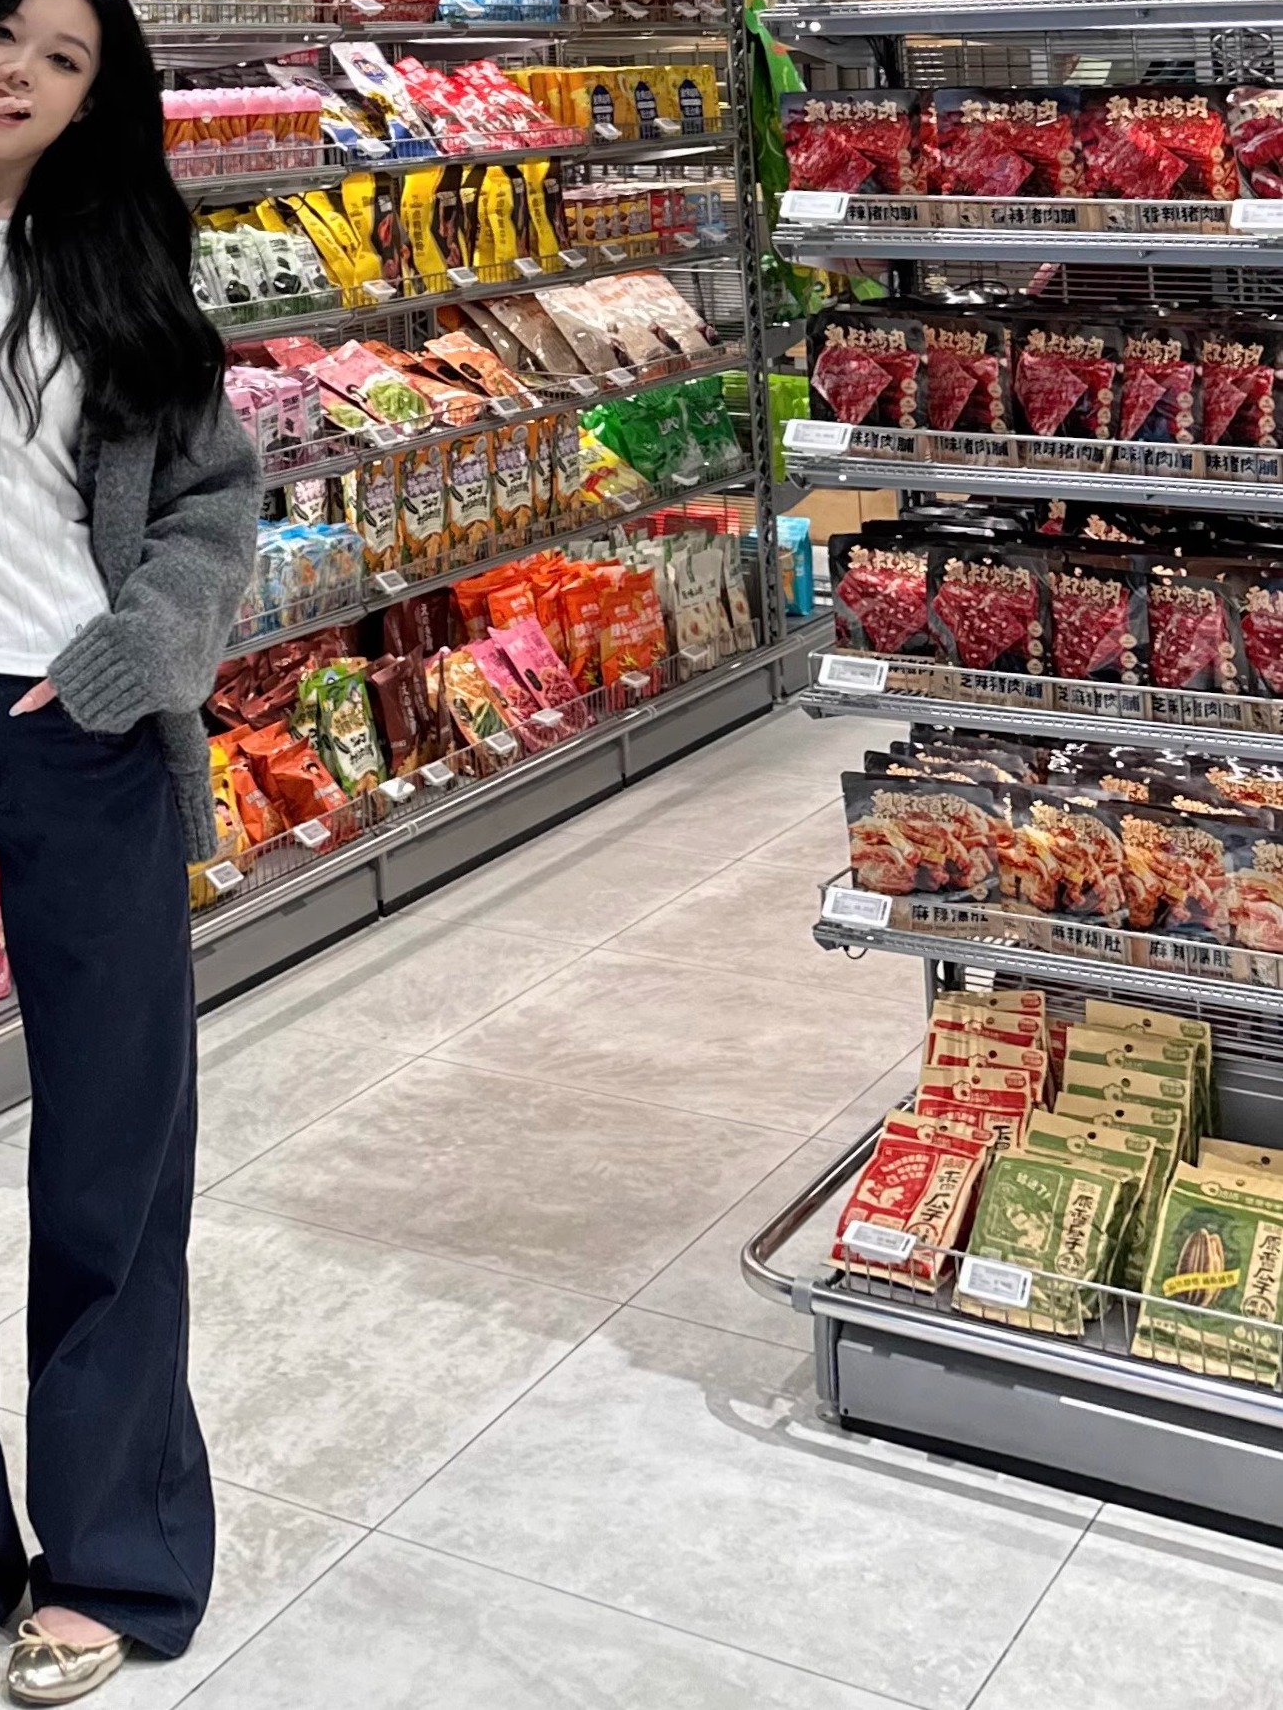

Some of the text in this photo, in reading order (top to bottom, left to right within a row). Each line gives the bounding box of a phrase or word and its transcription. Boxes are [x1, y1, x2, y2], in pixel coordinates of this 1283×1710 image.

[846, 205, 918, 222] 辣猪肉脯
[850, 431, 915, 454] 味猪肉脯
[1205, 454, 1279, 477] 味猪肉脯
[921, 1170, 962, 1222] 香瓜子
